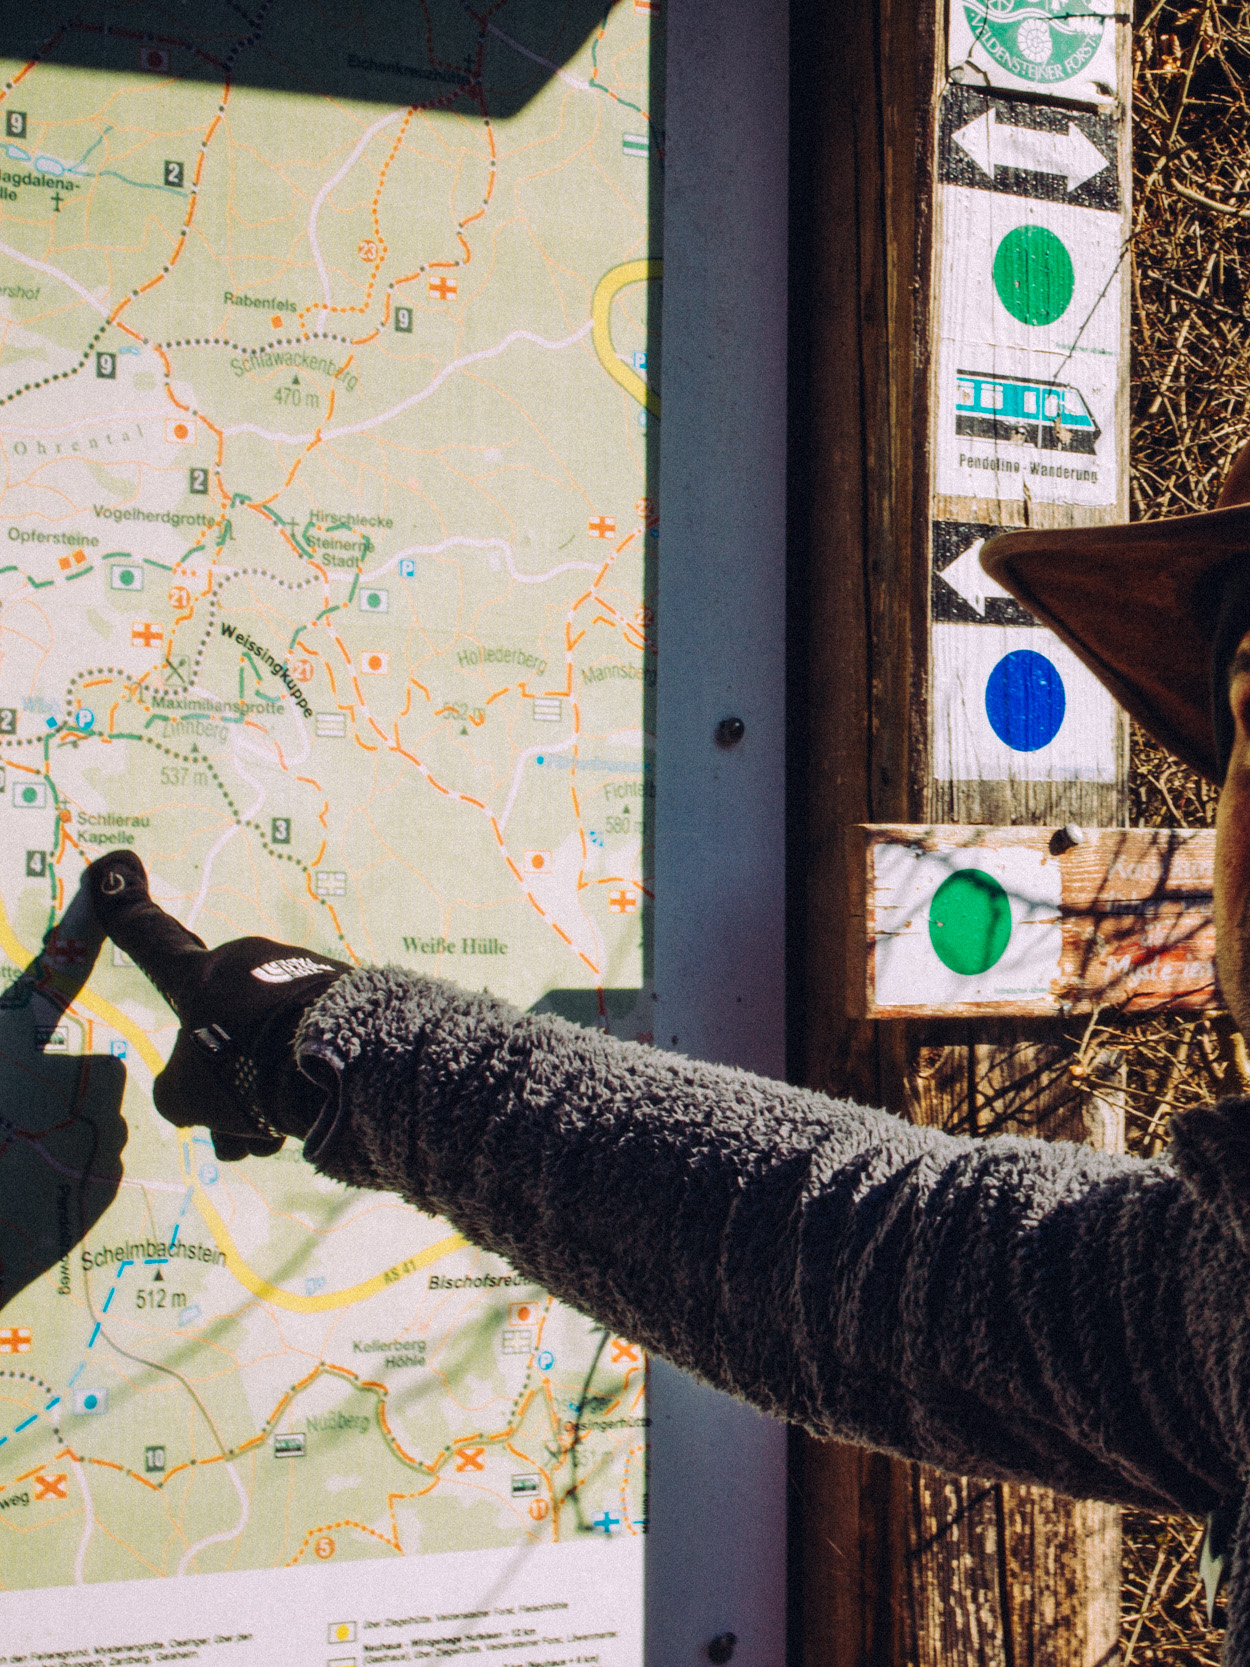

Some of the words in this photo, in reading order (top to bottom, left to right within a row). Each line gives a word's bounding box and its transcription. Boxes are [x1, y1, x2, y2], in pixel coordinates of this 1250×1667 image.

[970, 14, 1064, 81] VELDENSTEINER
[1064, 34, 1097, 75] FORST
[10, 114, 23, 134] 9
[0, 171, 80, 191] agdalena-
[167, 163, 180, 183] 2
[0, 286, 41, 300] rshof
[224, 291, 297, 312] Rabenfels
[399, 310, 410, 328] 9
[100, 356, 112, 375] 9
[273, 387, 301, 406] 470
[306, 393, 319, 408] m
[193, 472, 205, 491] 2
[93, 504, 216, 528] Vogelherdgrotte
[309, 509, 394, 529] Hirschlecke
[8, 527, 100, 547] Opfersteine
[322, 552, 360, 568] Stadt
[220, 621, 313, 719] Weissingkuppe
[78, 830, 135, 846] Kapelle
[274, 821, 287, 840] 3
[30, 853, 43, 873] 4
[402, 936, 457, 955] Weiße
[462, 936, 508, 955] Hülle
[81, 1238, 227, 1271] Schelmbachstein
[136, 1288, 167, 1309] 512
[171, 1292, 187, 1308] m
[147, 1450, 164, 1468] 10
